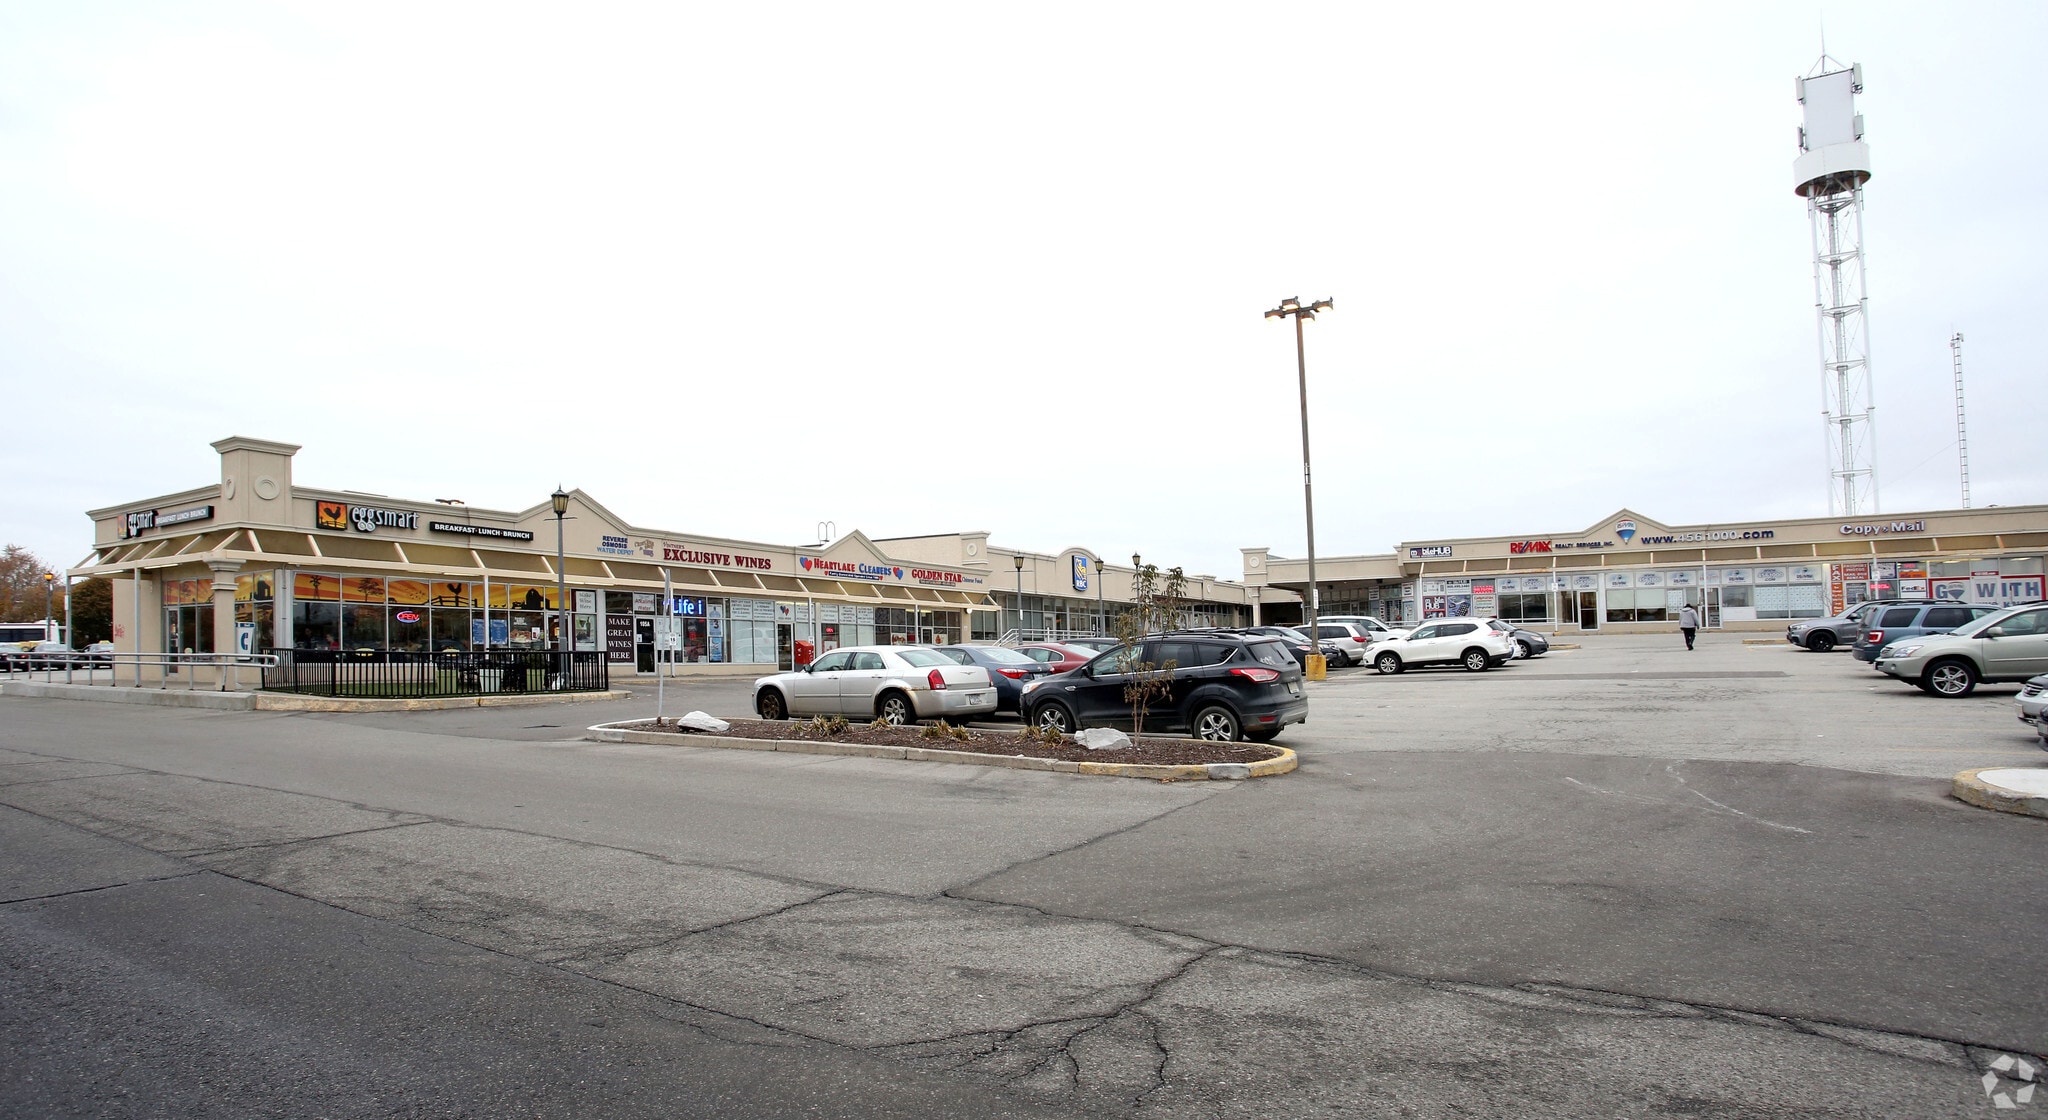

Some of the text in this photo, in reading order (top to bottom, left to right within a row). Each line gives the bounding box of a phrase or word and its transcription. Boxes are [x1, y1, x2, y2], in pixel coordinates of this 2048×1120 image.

[177, 511, 189, 521] LUNCH
[190, 508, 206, 518] BRUNCH
[352, 507, 419, 531] eggsmart
[128, 510, 154, 536] eggsmart
[1839, 524, 1880, 536] Copy
[1890, 520, 1925, 532] Mail
[434, 523, 530, 539] BREAKFAST LUNCH BRUNCH
[1641, 530, 1774, 544] www.4561000.com
[602, 535, 628, 543] REVERSE
[602, 541, 627, 549] OSMOSIS
[1510, 540, 1552, 554] RE/MAX
[663, 548, 731, 566] EXCLUSIVE
[734, 555, 771, 570] WINES
[813, 558, 891, 576] HEARTLAKE CLEANERS
[911, 569, 943, 581] GOLDEN
[944, 572, 962, 583] STAR
[1076, 580, 1087, 588] RBC
[672, 599, 695, 614] Life
[400, 613, 419, 621] OPEN
[608, 618, 631, 626] MAKE
[713, 619, 719, 629] 3
[607, 629, 632, 637] GREAT
[607, 640, 632, 648] WINES
[610, 651, 631, 659] HERE
